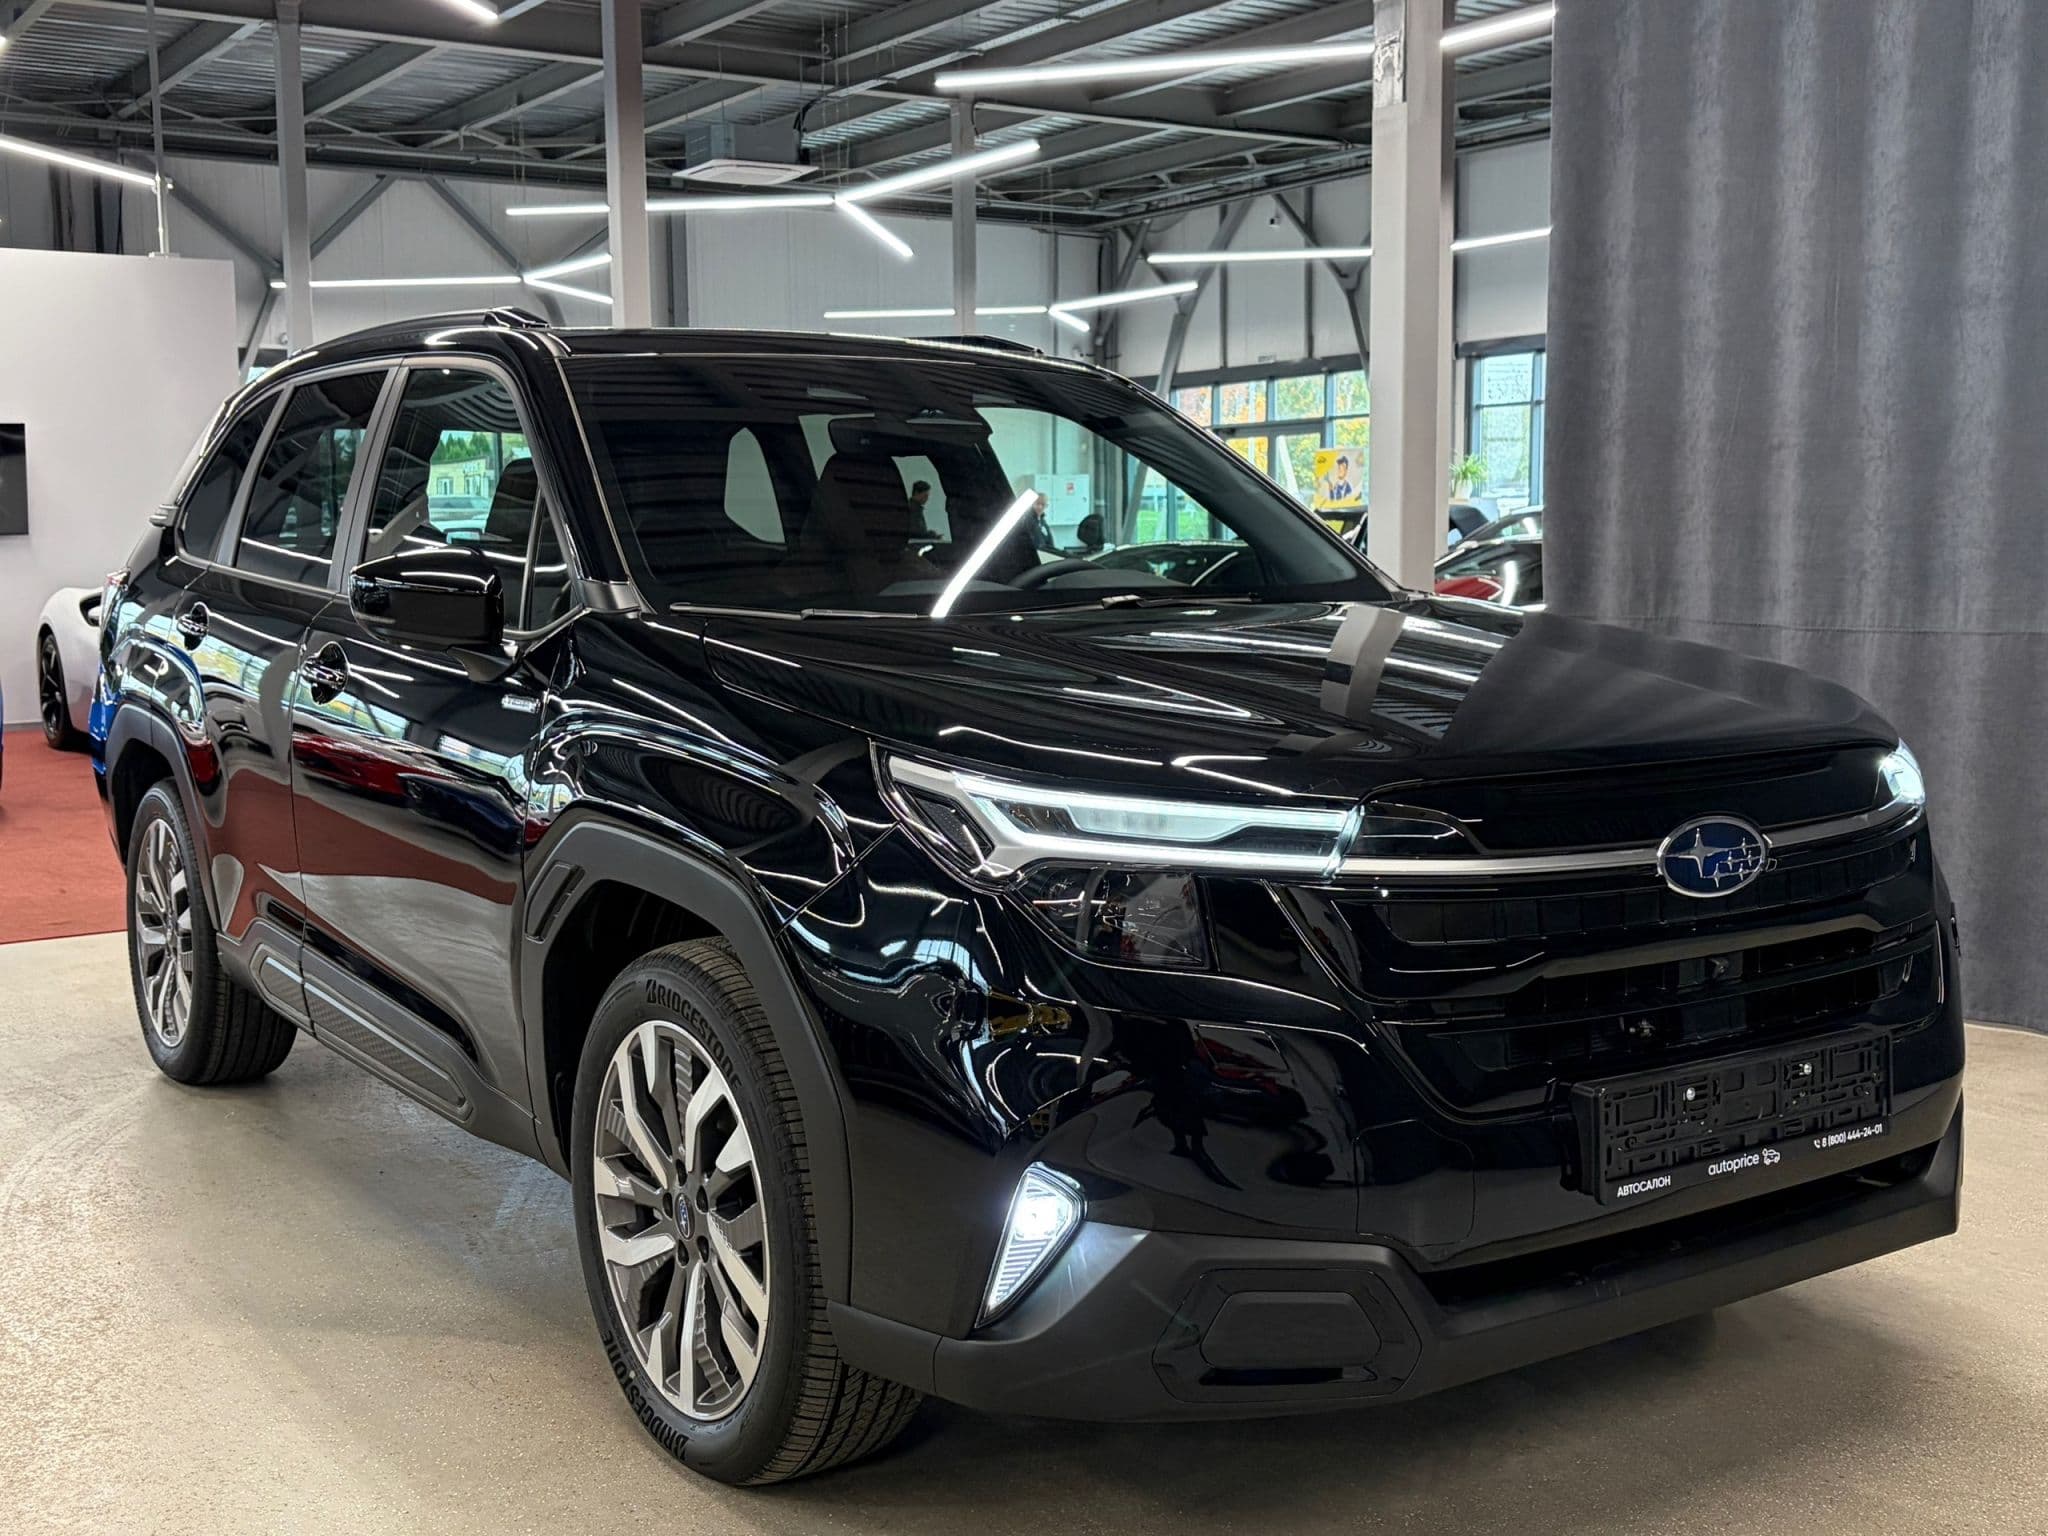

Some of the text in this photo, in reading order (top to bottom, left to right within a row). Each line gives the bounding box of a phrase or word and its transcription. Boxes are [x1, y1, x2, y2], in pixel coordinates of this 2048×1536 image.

[646, 979, 742, 1091] BRIDGESTONE
[1821, 1123, 1883, 1148] 8 (800) 444-24-01
[1708, 1153, 1760, 1175] autoprice
[1617, 1175, 1671, 1197] АВТОСАЛОН
